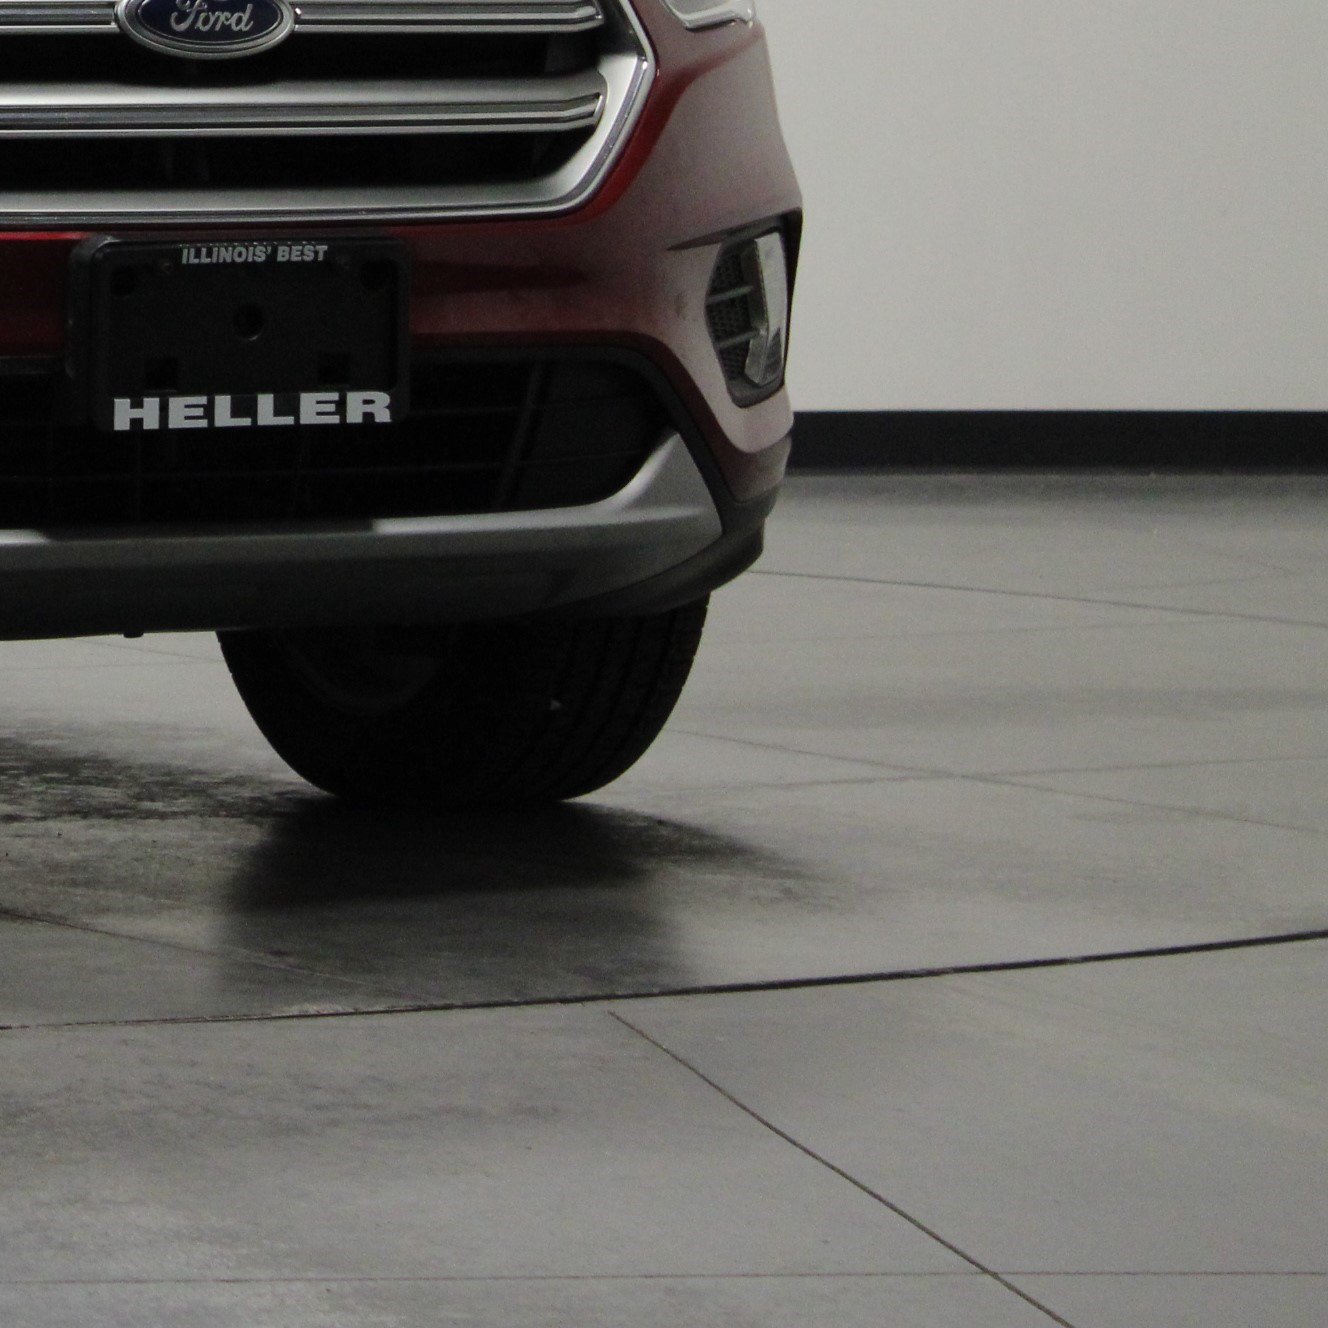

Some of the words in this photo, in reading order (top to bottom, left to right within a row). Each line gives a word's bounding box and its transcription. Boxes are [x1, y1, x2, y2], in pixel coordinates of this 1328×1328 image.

[181, 246, 272, 264] ILLINOIS'
[277, 245, 328, 262] BEST
[113, 391, 392, 431] HELLER
